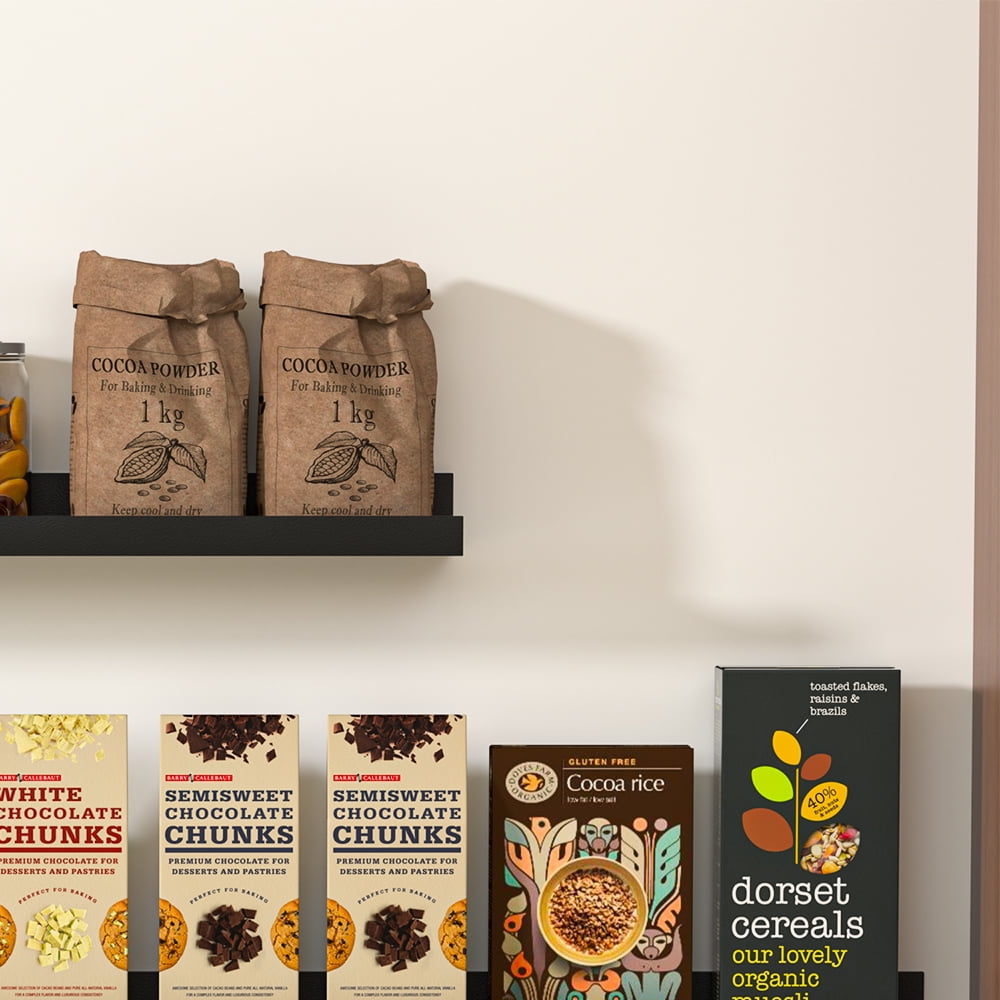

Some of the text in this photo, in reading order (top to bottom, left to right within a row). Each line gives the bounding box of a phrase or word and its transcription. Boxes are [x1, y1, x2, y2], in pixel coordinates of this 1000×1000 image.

[92, 357, 220, 378] COCOA POWDER
[282, 357, 410, 378] COCOA POWDER
[100, 379, 212, 398] For Baking & Drinking
[291, 379, 401, 398] For Baking & Drinking
[141, 400, 185, 431] 1 kg
[332, 400, 376, 431] 1 kg
[111, 503, 202, 516] Keep cool and dry
[301, 503, 392, 516] Keep cool and dry
[810, 682, 888, 692] toasted flakes,
[810, 694, 860, 704] raisins &
[810, 706, 847, 716] brazils
[509, 764, 534, 784] DOVES
[566, 774, 665, 792] Cocoa rice
[164, 789, 293, 802] SEMISWEET
[332, 789, 461, 802] SEMISWEET
[511, 785, 554, 801] ORGANIC
[807, 786, 837, 809] 40%
[164, 807, 293, 819] CHOCOLATE
[332, 807, 461, 819] CHOCOLATE
[164, 825, 293, 844] CHUNKS
[332, 825, 461, 844] CHUNKS
[18, 888, 50, 904] PERFECT
[70, 888, 98, 904] BAKING
[189, 888, 221, 904] PERFECT
[241, 888, 269, 904] BAKING
[357, 888, 389, 904] PERFECT
[409, 888, 437, 904] BAKING
[731, 876, 850, 905] dorset
[731, 910, 864, 939] cereals
[731, 945, 848, 968] our lovely
[731, 969, 820, 991] organic
